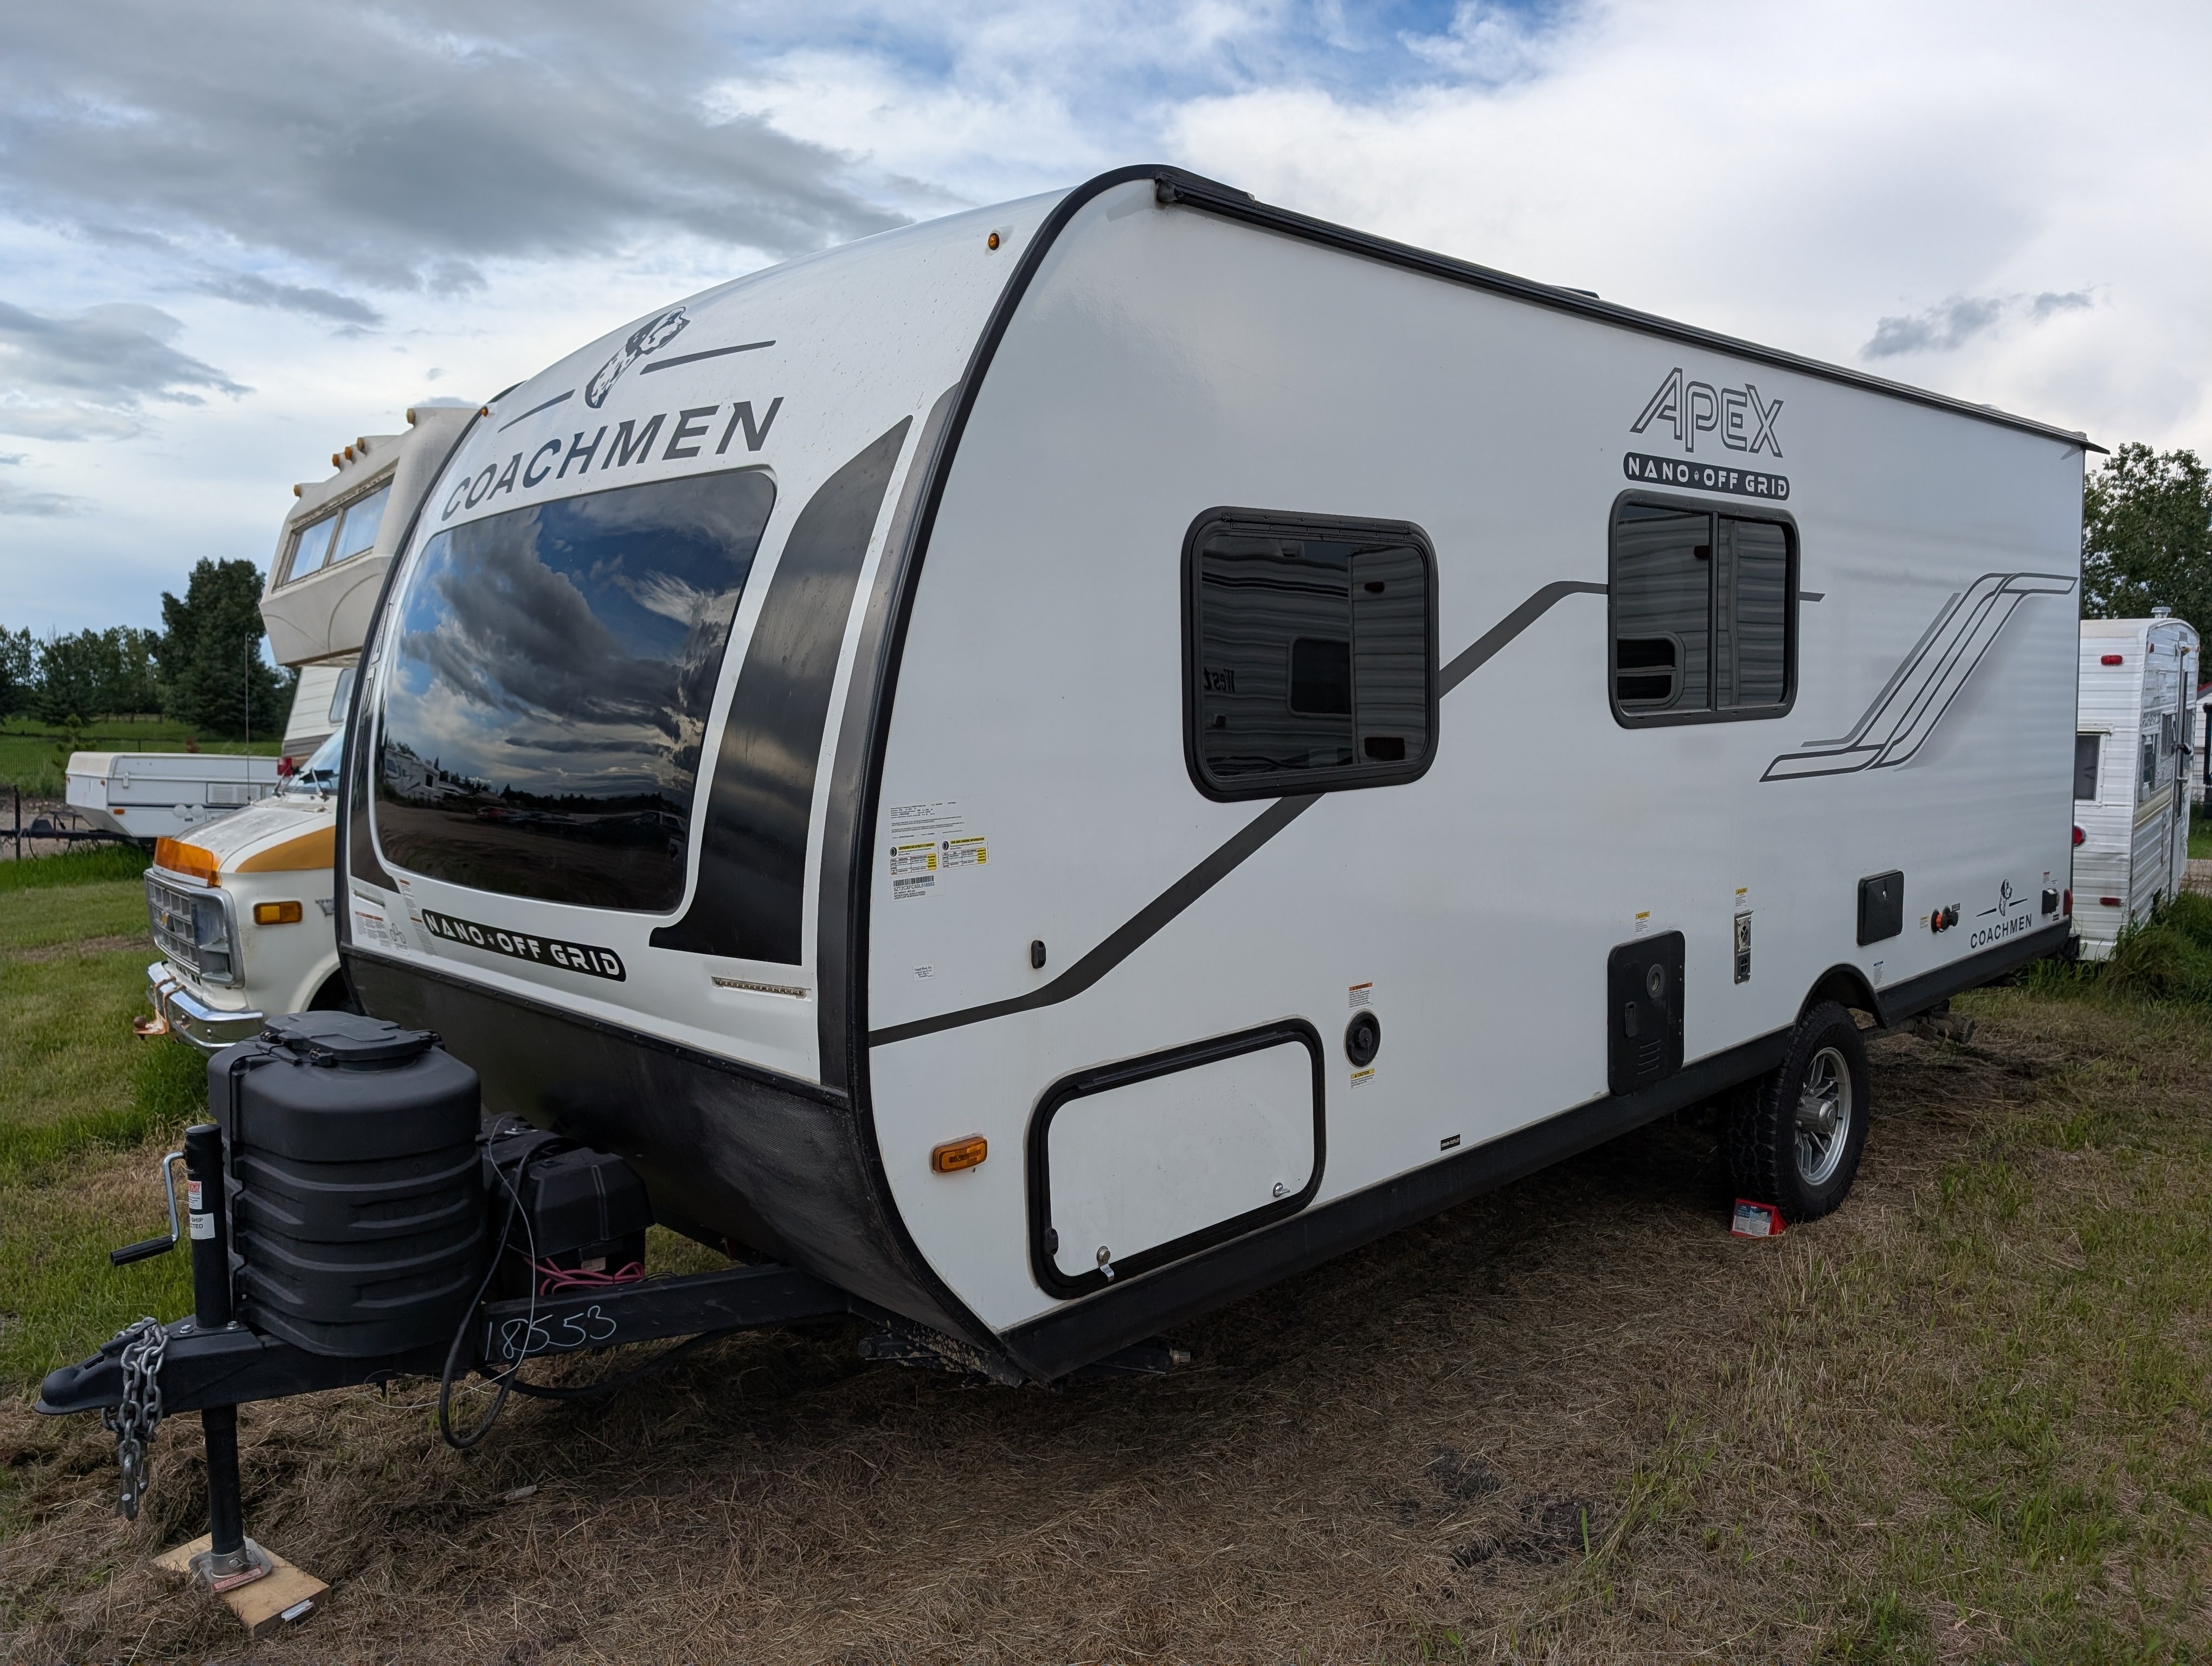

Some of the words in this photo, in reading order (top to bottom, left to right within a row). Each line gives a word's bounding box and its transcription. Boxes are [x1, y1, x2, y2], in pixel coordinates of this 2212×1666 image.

[1629, 367, 1784, 458] APEX
[441, 396, 784, 522] COACHMEN
[1629, 456, 1689, 482] NANO
[1703, 469, 1738, 489] OFF
[1745, 475, 1787, 496] GRID
[425, 914, 485, 945] NANO
[497, 933, 541, 958] OFF
[550, 944, 620, 975] GRID
[1970, 913, 2032, 949] COACHMEN
[485, 1305, 616, 1360] 18553
